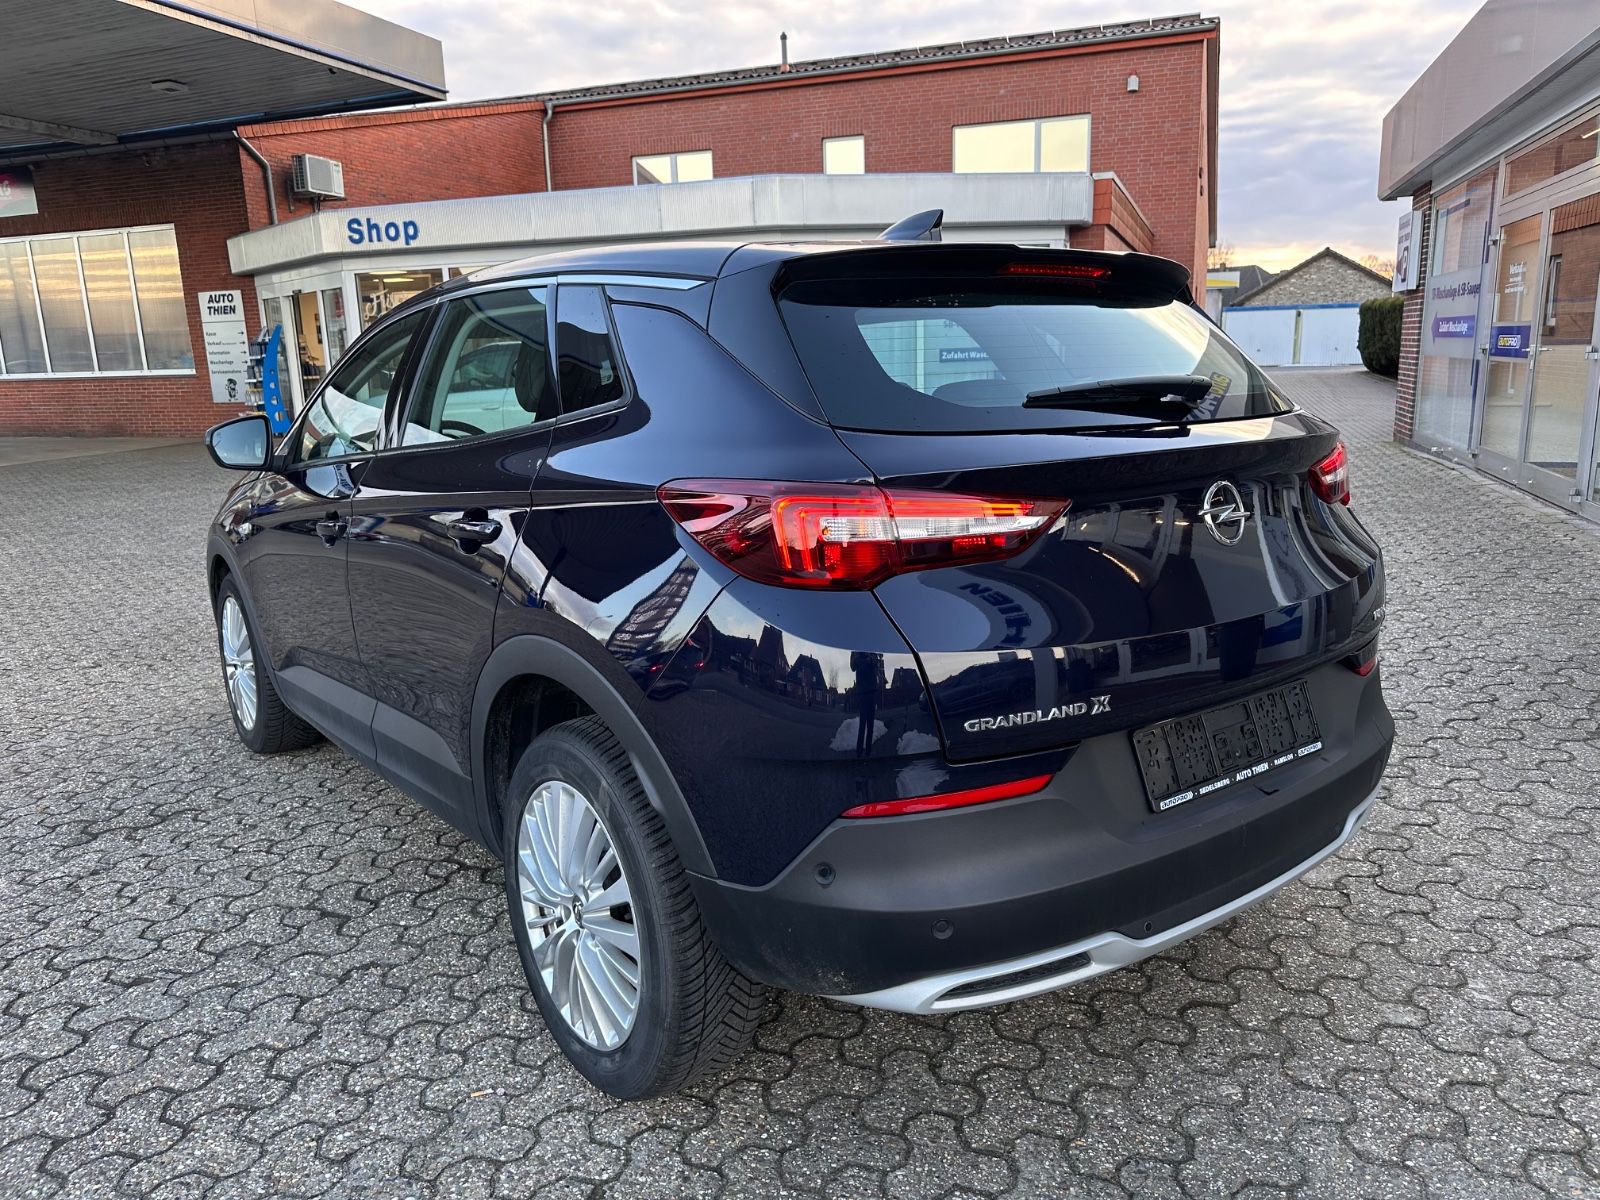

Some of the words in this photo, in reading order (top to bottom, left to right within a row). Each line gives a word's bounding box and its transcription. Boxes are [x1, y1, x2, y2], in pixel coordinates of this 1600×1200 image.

[347, 218, 419, 246] Shop
[208, 293, 234, 304] AUTO
[207, 305, 236, 316] THIEN
[942, 351, 968, 359] Zufahrt
[964, 702, 1087, 732] GRANDLAND
[1090, 694, 1112, 715] X
[1199, 778, 1230, 794] SEDELSBERG
[1235, 769, 1252, 782] AUTO
[1252, 762, 1269, 776] THIEN
